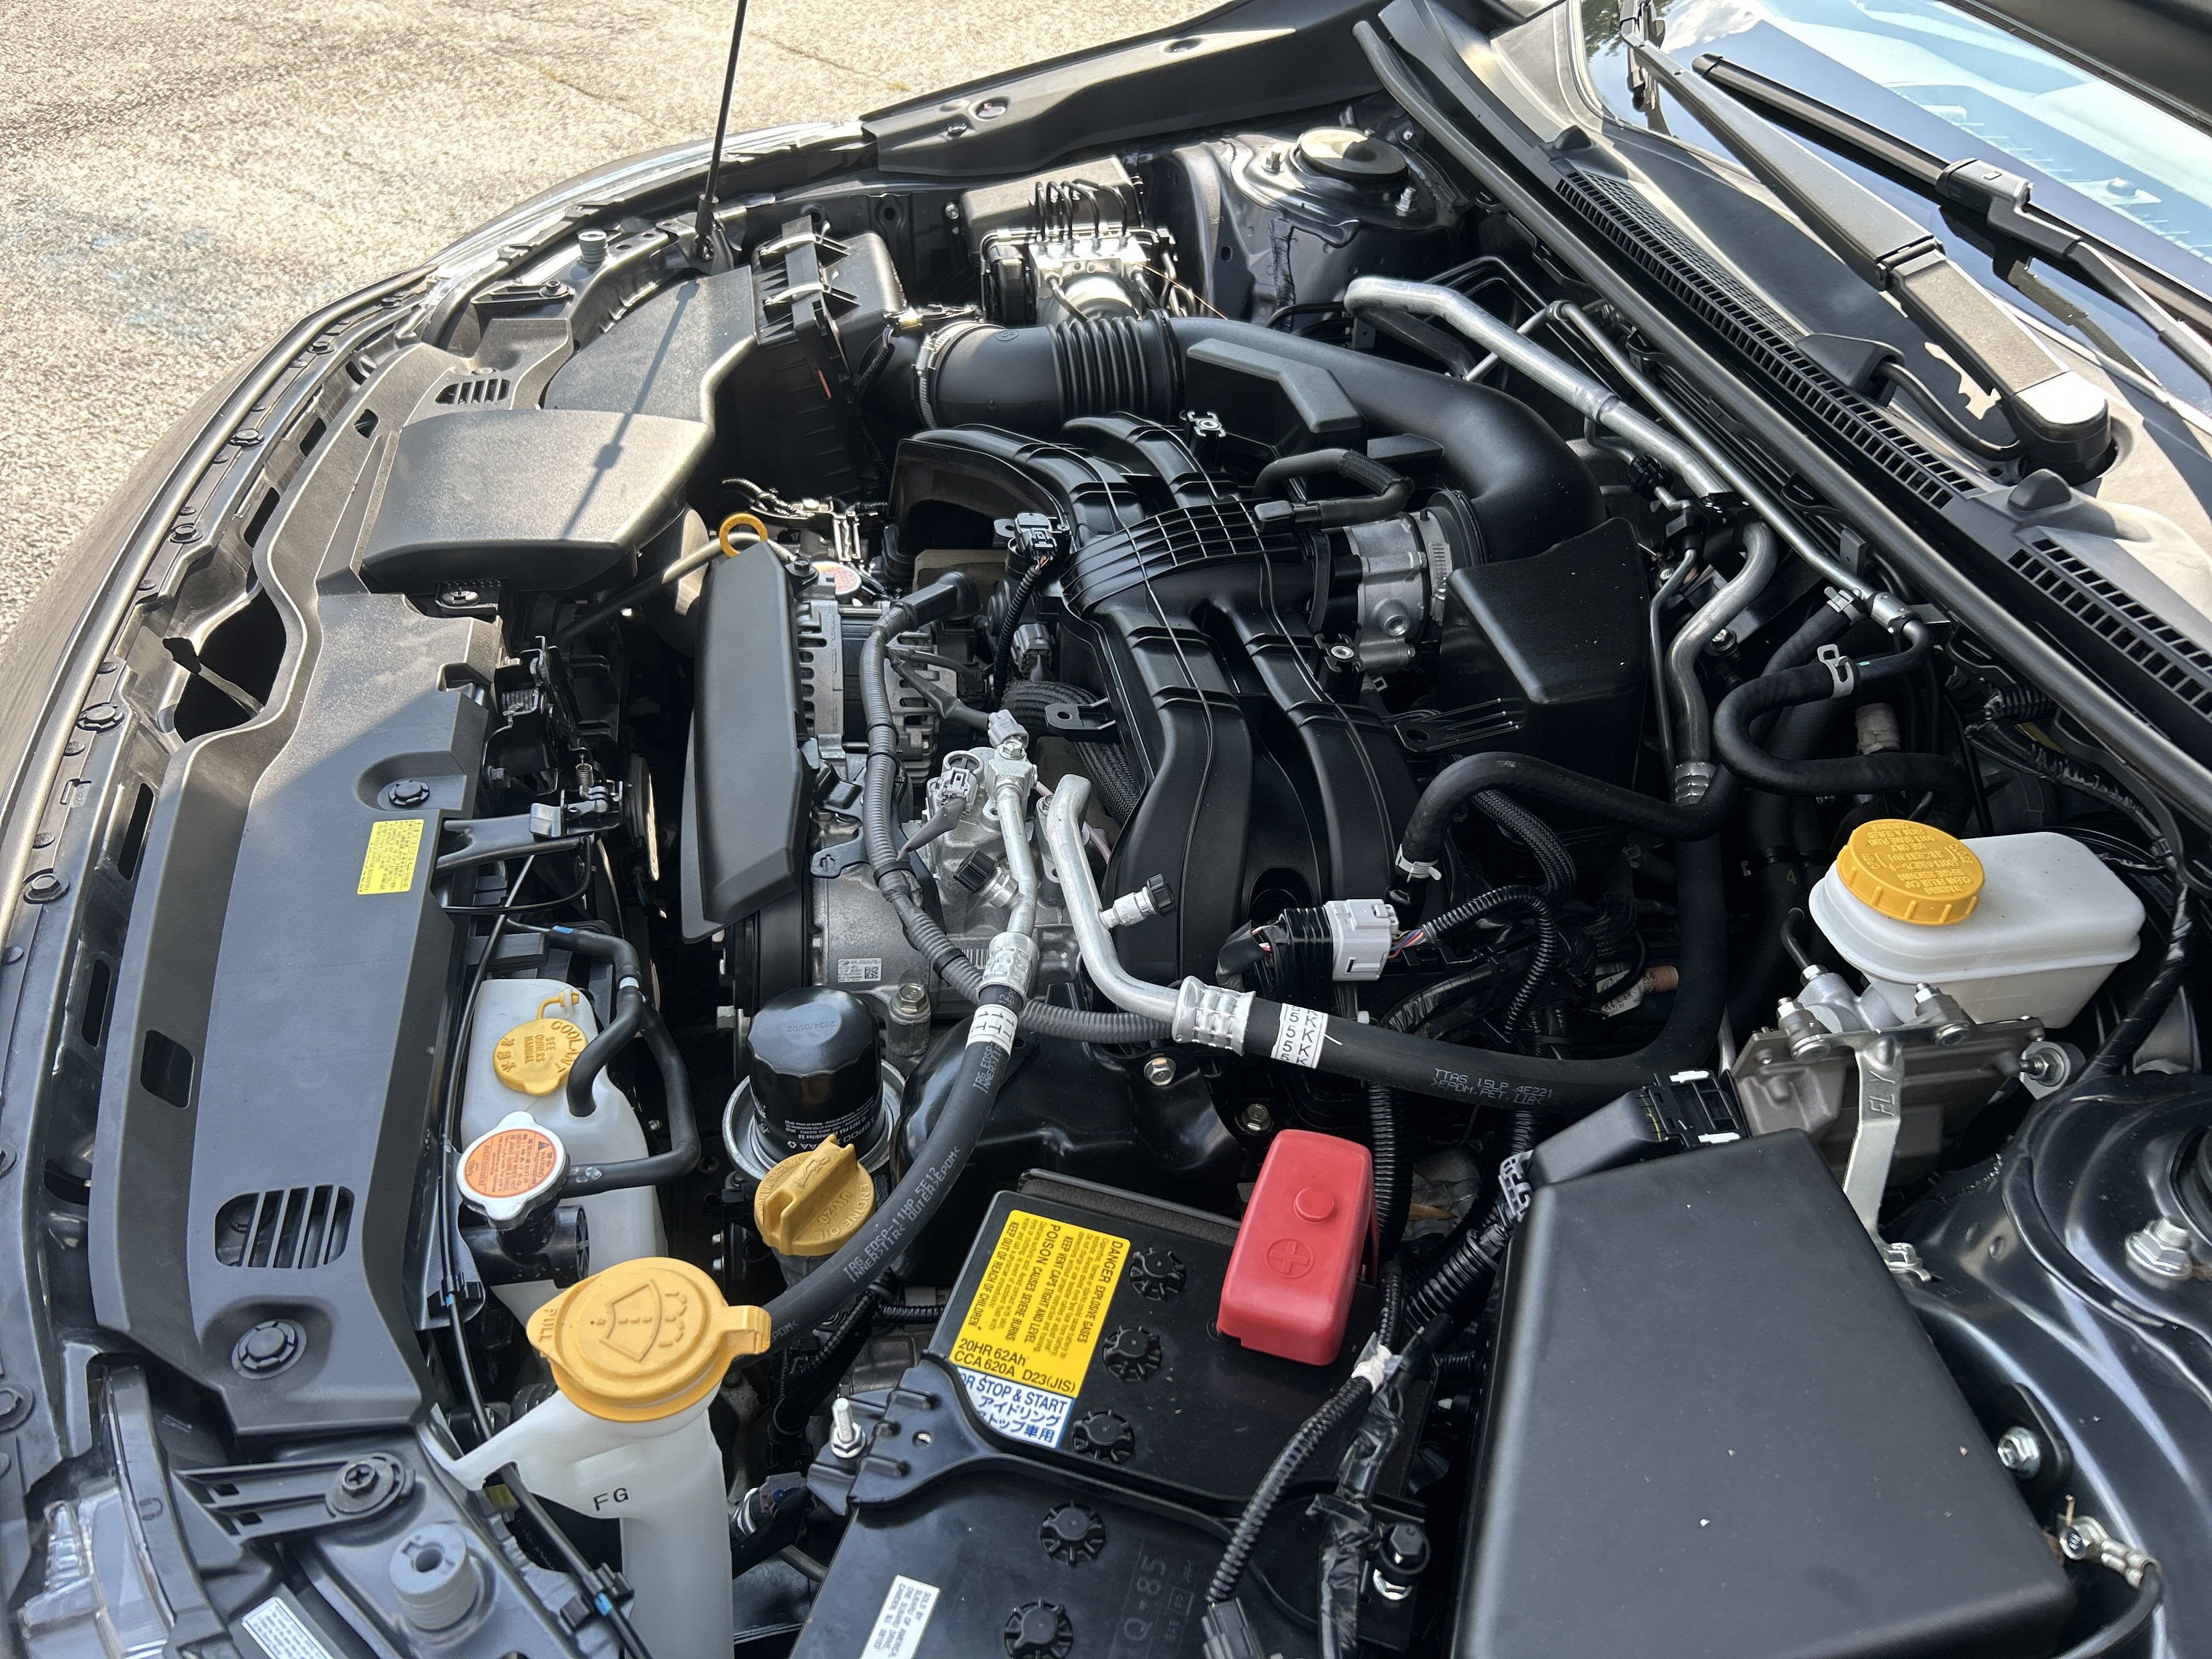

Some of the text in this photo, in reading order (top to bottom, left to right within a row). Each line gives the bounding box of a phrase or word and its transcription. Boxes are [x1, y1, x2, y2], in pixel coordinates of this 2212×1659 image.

[1866, 830, 1894, 838] SEALED
[1867, 834, 1935, 846] DOT3 BRAKE FLUID
[1869, 822, 1910, 831] CONTAINER
[1911, 842, 1926, 850] USE
[1948, 843, 1973, 864] CLOSE
[1860, 853, 1880, 869] OPEN
[1897, 868, 1965, 881] BEFORE REMOVING
[1905, 876, 1971, 888] CLEAN FILLER CAP
[1923, 884, 1962, 894] WARNING
[786, 1020, 835, 1032] 2024/01/02
[1286, 1025, 1314, 1043] 5 K
[1289, 1012, 1317, 1028] 5 K
[524, 1035, 534, 1064] MANUAL
[534, 1034, 545, 1062] OWNERS
[545, 1036, 555, 1051] SEE
[550, 1020, 582, 1073] COOLANT
[1283, 1040, 1311, 1057] 5 K
[1432, 1067, 1469, 1085] TTAS
[1869, 1070, 1895, 1117] FLY
[805, 1131, 838, 1139] Aomobiles
[478, 1145, 489, 1187] AVERTISSEMENT
[538, 1150, 546, 1178] WARNING
[815, 1183, 871, 1240] ENGINE OIL
[967, 1220, 1020, 1328] KEEP OUT OF REACH OF CHILDREN
[1003, 1223, 1062, 1342] POISON CAUSES SEVERE BURNS
[1023, 1235, 1074, 1345] KEEP VENT CAPS TIGHT AND LEVEL
[1076, 1240, 1124, 1344] DANGER EXPLOSIVE GASES
[539, 1308, 557, 1342] PULL
[767, 1316, 799, 1345] PDM<
[958, 1338, 1026, 1367] 20HR 62Ah
[954, 1350, 1076, 1393] CCA 620A D23(JIS)
[977, 1376, 1012, 1398] STOP
[1013, 1389, 1022, 1402] &
[1024, 1392, 1068, 1414] START
[979, 1395, 1061, 1426] アイドリング
[1118, 1554, 1173, 1645] Q-85
